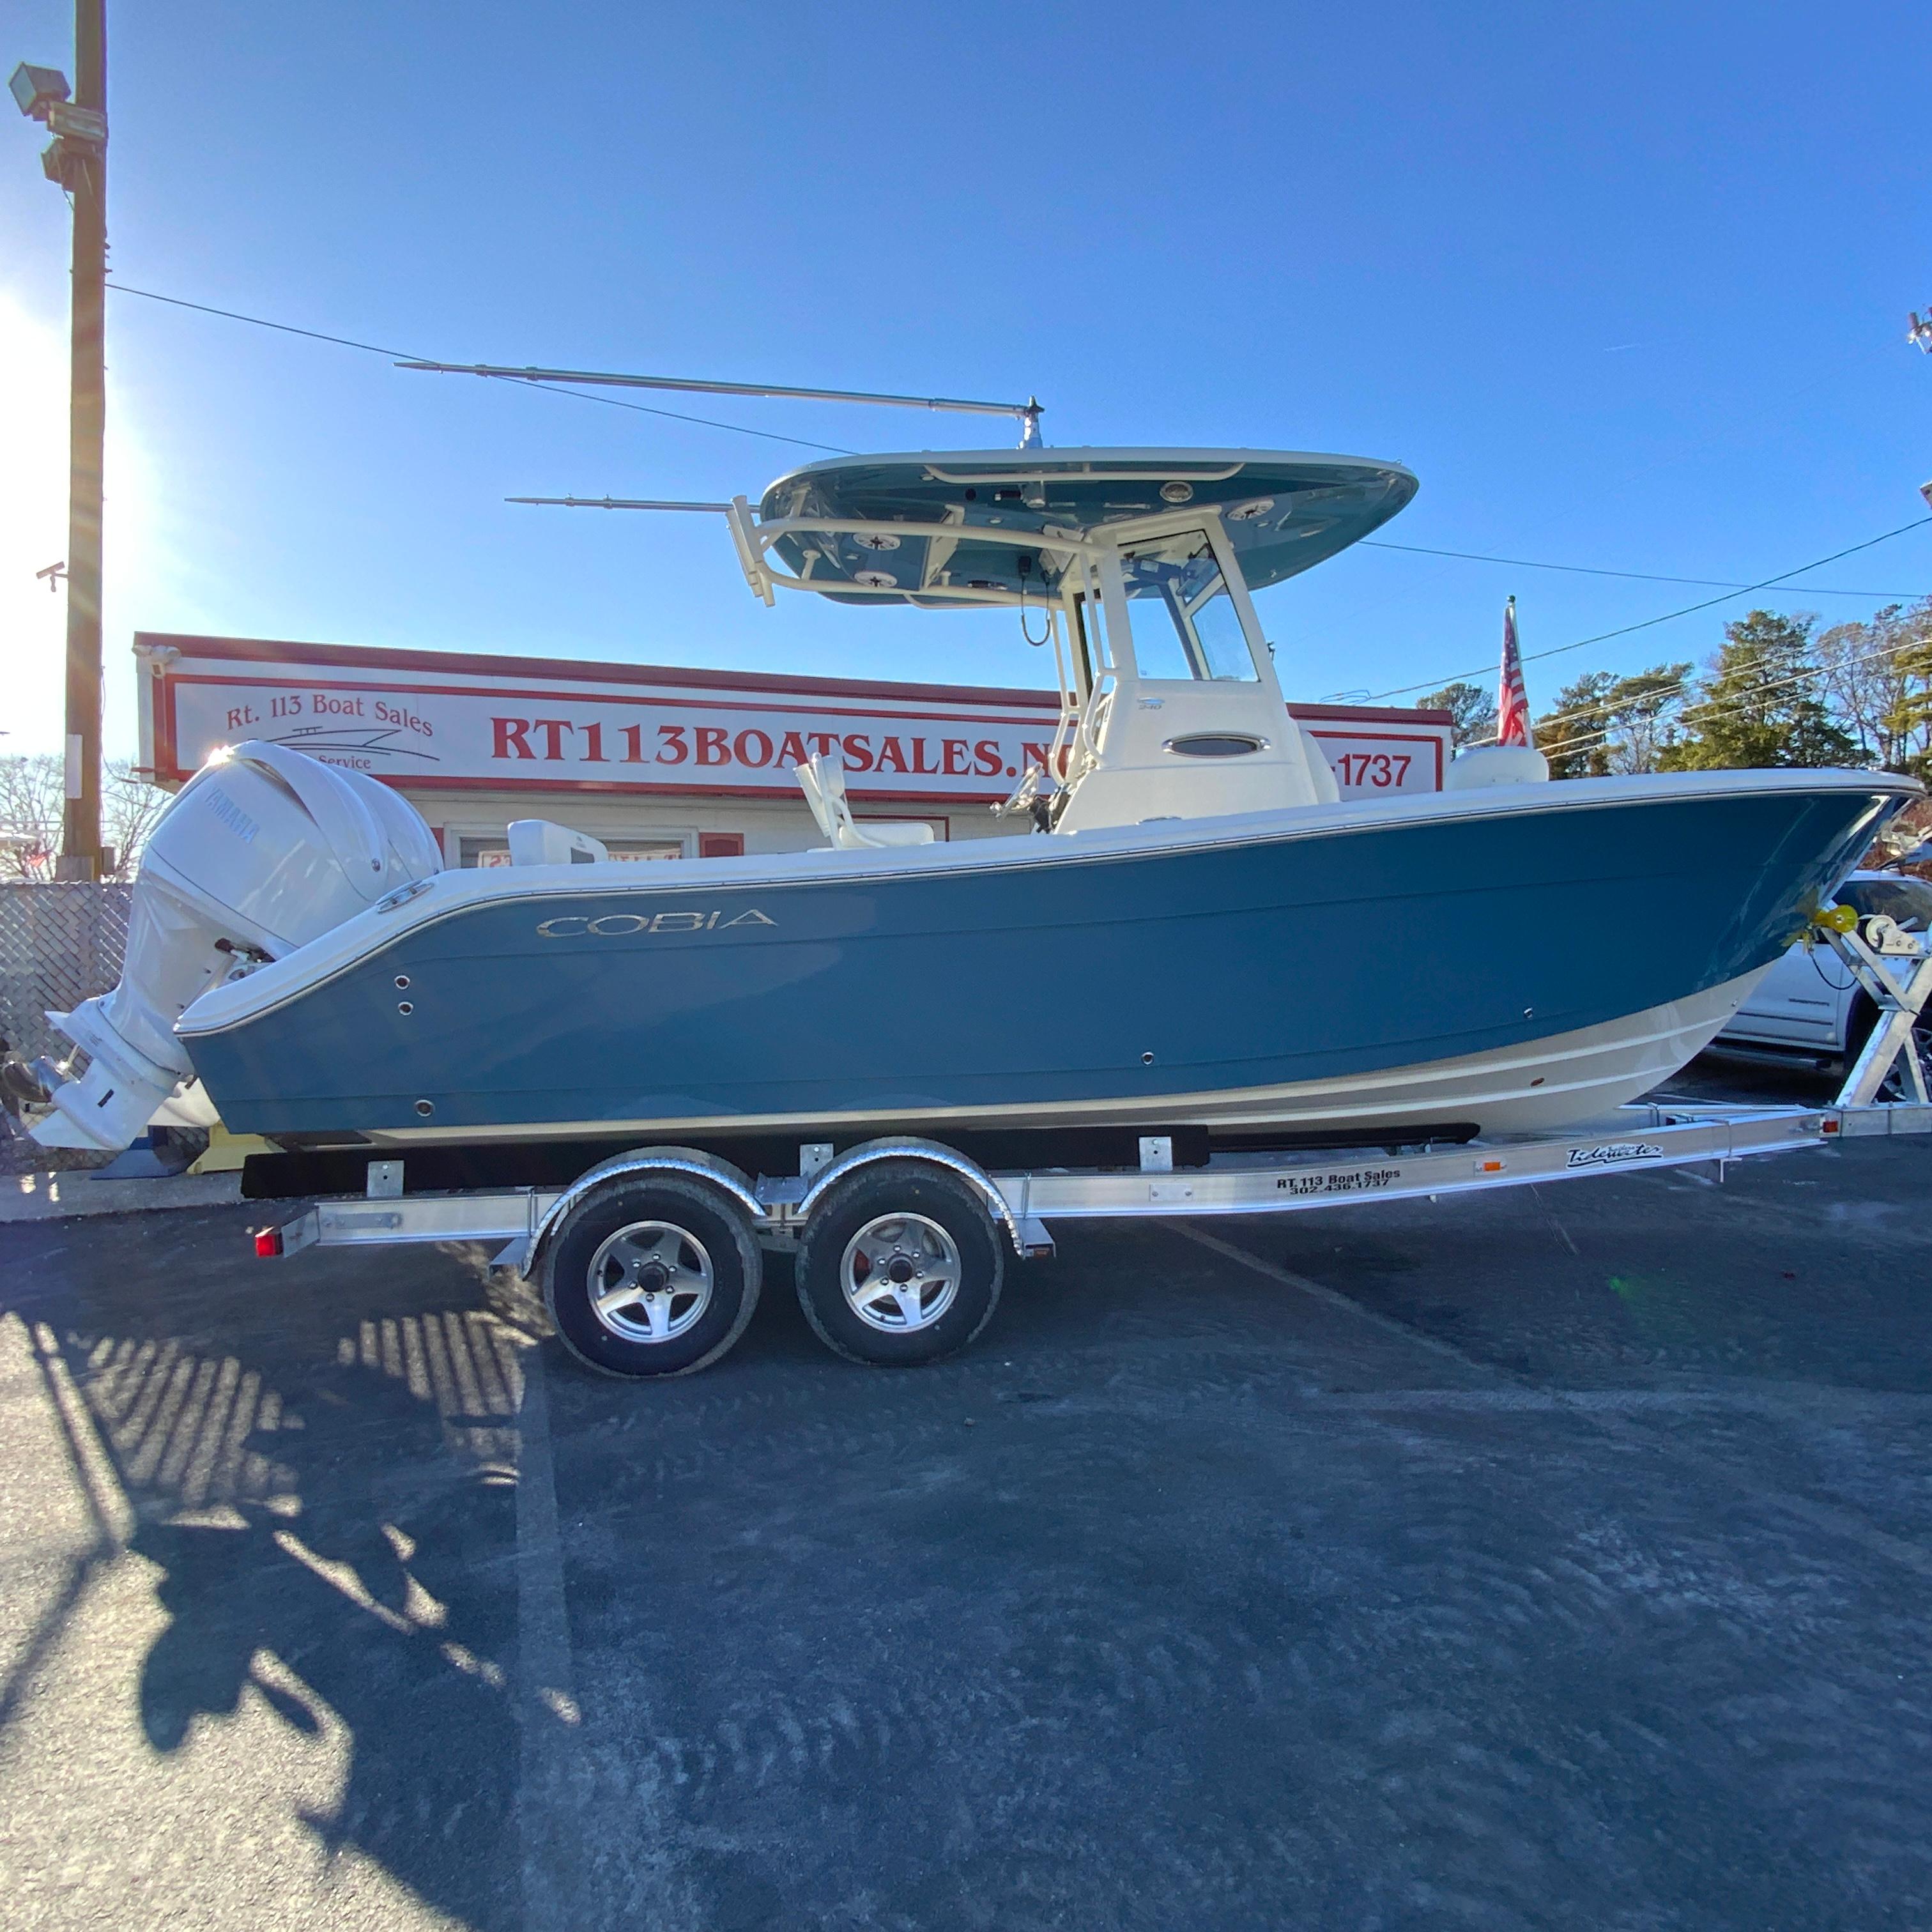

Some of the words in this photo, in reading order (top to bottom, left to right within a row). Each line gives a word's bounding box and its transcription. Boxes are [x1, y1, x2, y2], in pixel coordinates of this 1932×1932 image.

[227, 705, 259, 730] Rt.
[270, 695, 302, 718] 113
[312, 694, 365, 717] Boat
[375, 701, 433, 737] Sales
[205, 787, 261, 844] YAMAHA
[535, 908, 779, 937] COBIA
[1289, 1179, 1390, 1195] 302.436.1737
[1328, 1172, 1360, 1184] Boat
[1364, 1169, 1400, 1182] Sales
